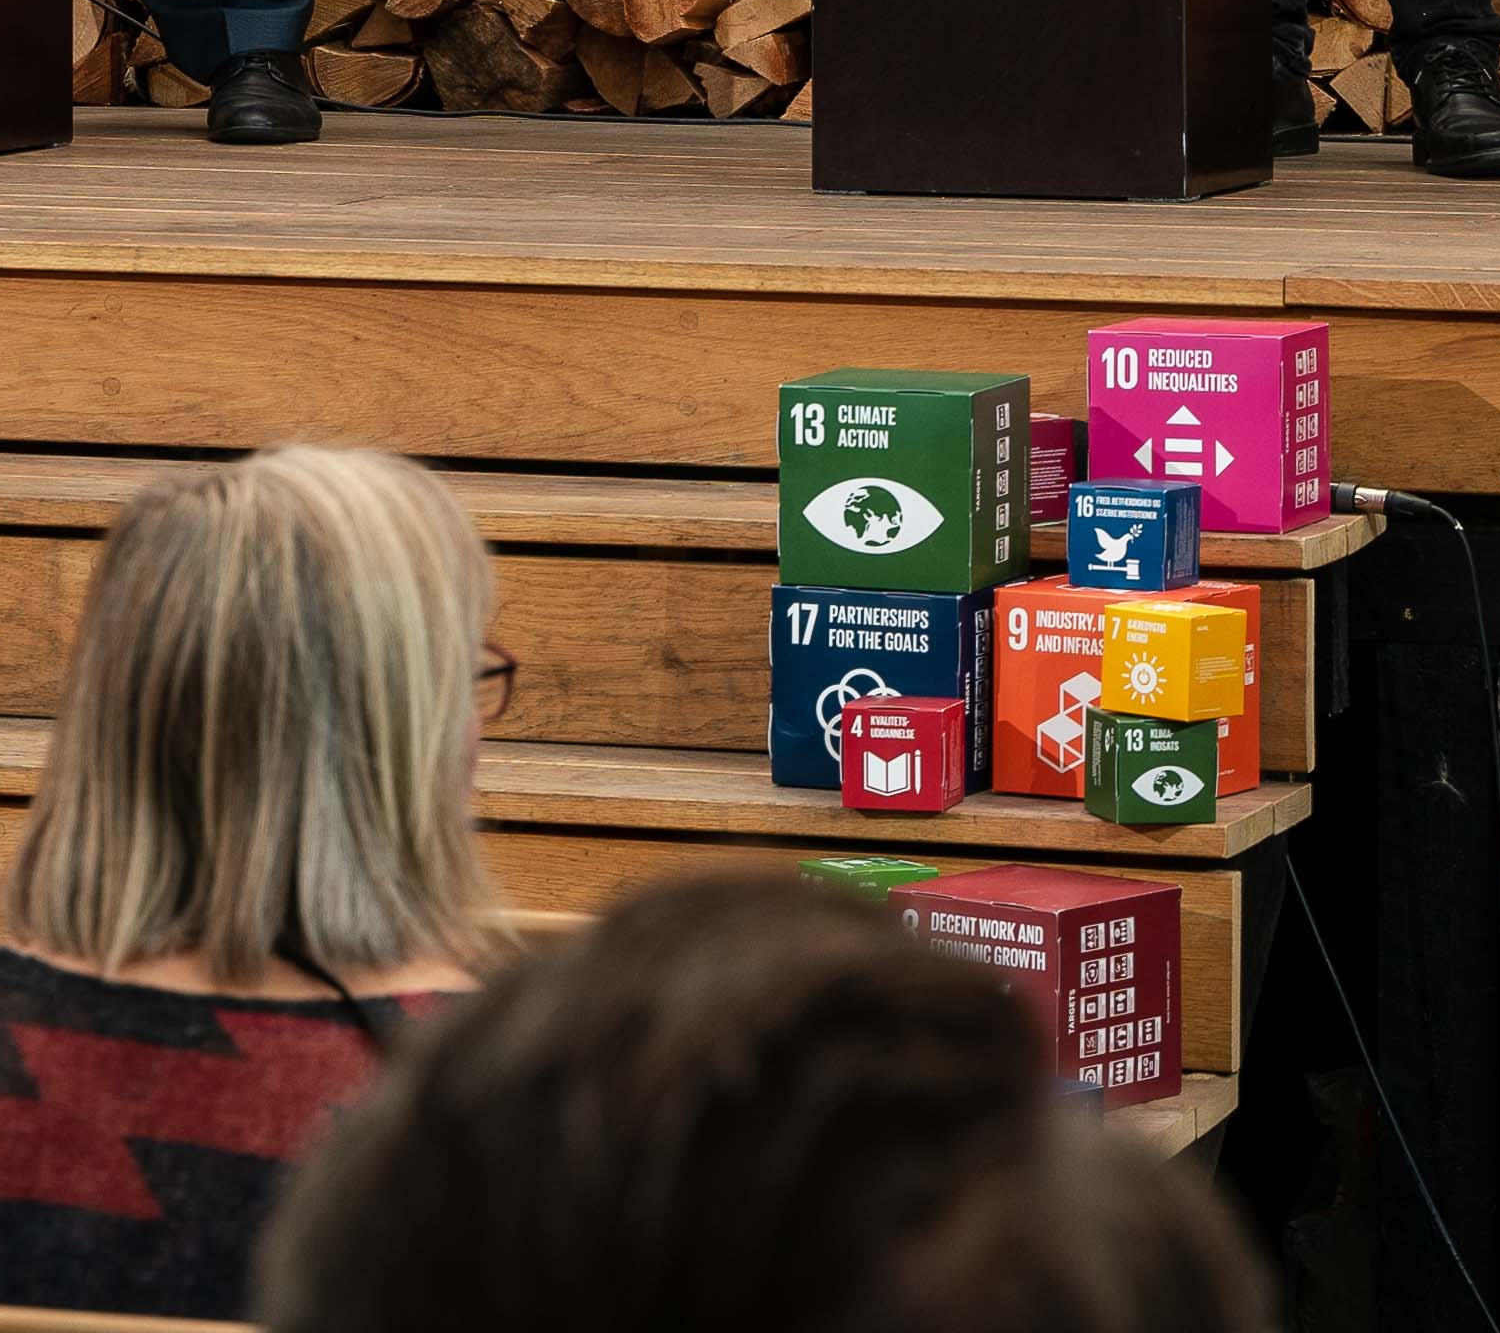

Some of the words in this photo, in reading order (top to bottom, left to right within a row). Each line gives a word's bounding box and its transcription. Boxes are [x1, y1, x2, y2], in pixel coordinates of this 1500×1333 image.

[1101, 346, 1139, 391] 10
[1147, 348, 1213, 369] REDUCED
[1147, 371, 1239, 393] INEQUALITIES
[790, 403, 825, 446] 13
[837, 404, 897, 427] CLIMATE
[837, 427, 890, 449] ACTION
[1075, 495, 1094, 518] 16
[786, 602, 819, 646] 17
[828, 604, 929, 629] PARTNERSHIPS
[1035, 610, 1097, 633] INDUSTRY,
[1111, 617, 1121, 640] 7
[828, 629, 854, 649] FOR
[856, 630, 882, 651] THE
[884, 632, 930, 654] GOALS
[1007, 607, 1029, 652] 9
[1035, 634, 1062, 653] AND
[850, 714, 864, 738] 4
[1124, 729, 1144, 752] 13
[930, 911, 978, 938] DECENT
[978, 917, 1016, 942] WORK
[1017, 923, 1044, 945] AND
[993, 945, 1047, 972] GROWTH
[1067, 988, 1076, 1036] TARGETS
